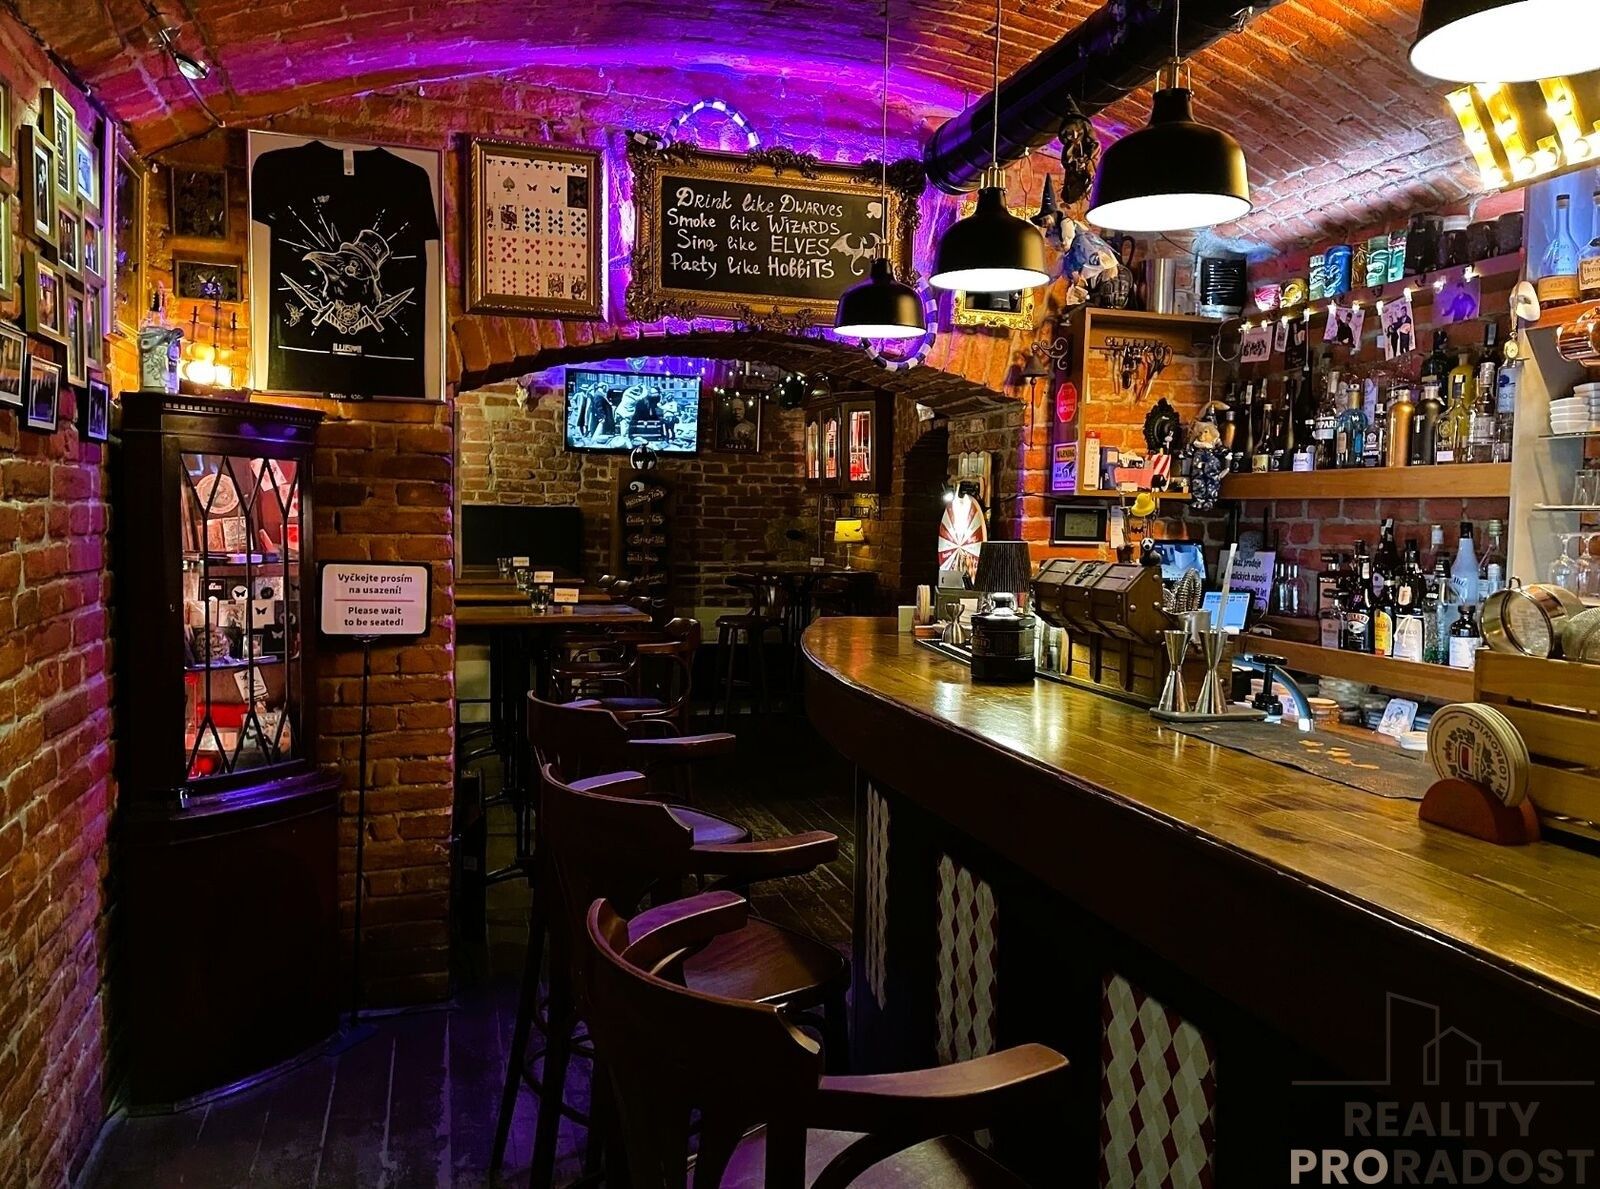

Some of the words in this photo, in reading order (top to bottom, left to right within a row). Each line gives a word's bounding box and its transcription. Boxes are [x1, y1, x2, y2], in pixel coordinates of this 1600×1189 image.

[742, 193, 774, 213] like
[667, 208, 717, 228] Smoke
[730, 215, 760, 232] like
[677, 229, 717, 252] Sing
[727, 236, 757, 251] like
[771, 235, 830, 257] ELVES
[727, 255, 760, 275] like
[338, 573, 379, 583] Vyčkejte
[380, 574, 413, 583] prosím
[363, 585, 402, 594] usazení!
[348, 606, 379, 614] Please
[381, 606, 402, 614] wait
[356, 618, 368, 626] be
[369, 618, 404, 626] seated!
[1468, 718, 1507, 781] LOBKOWICZ
